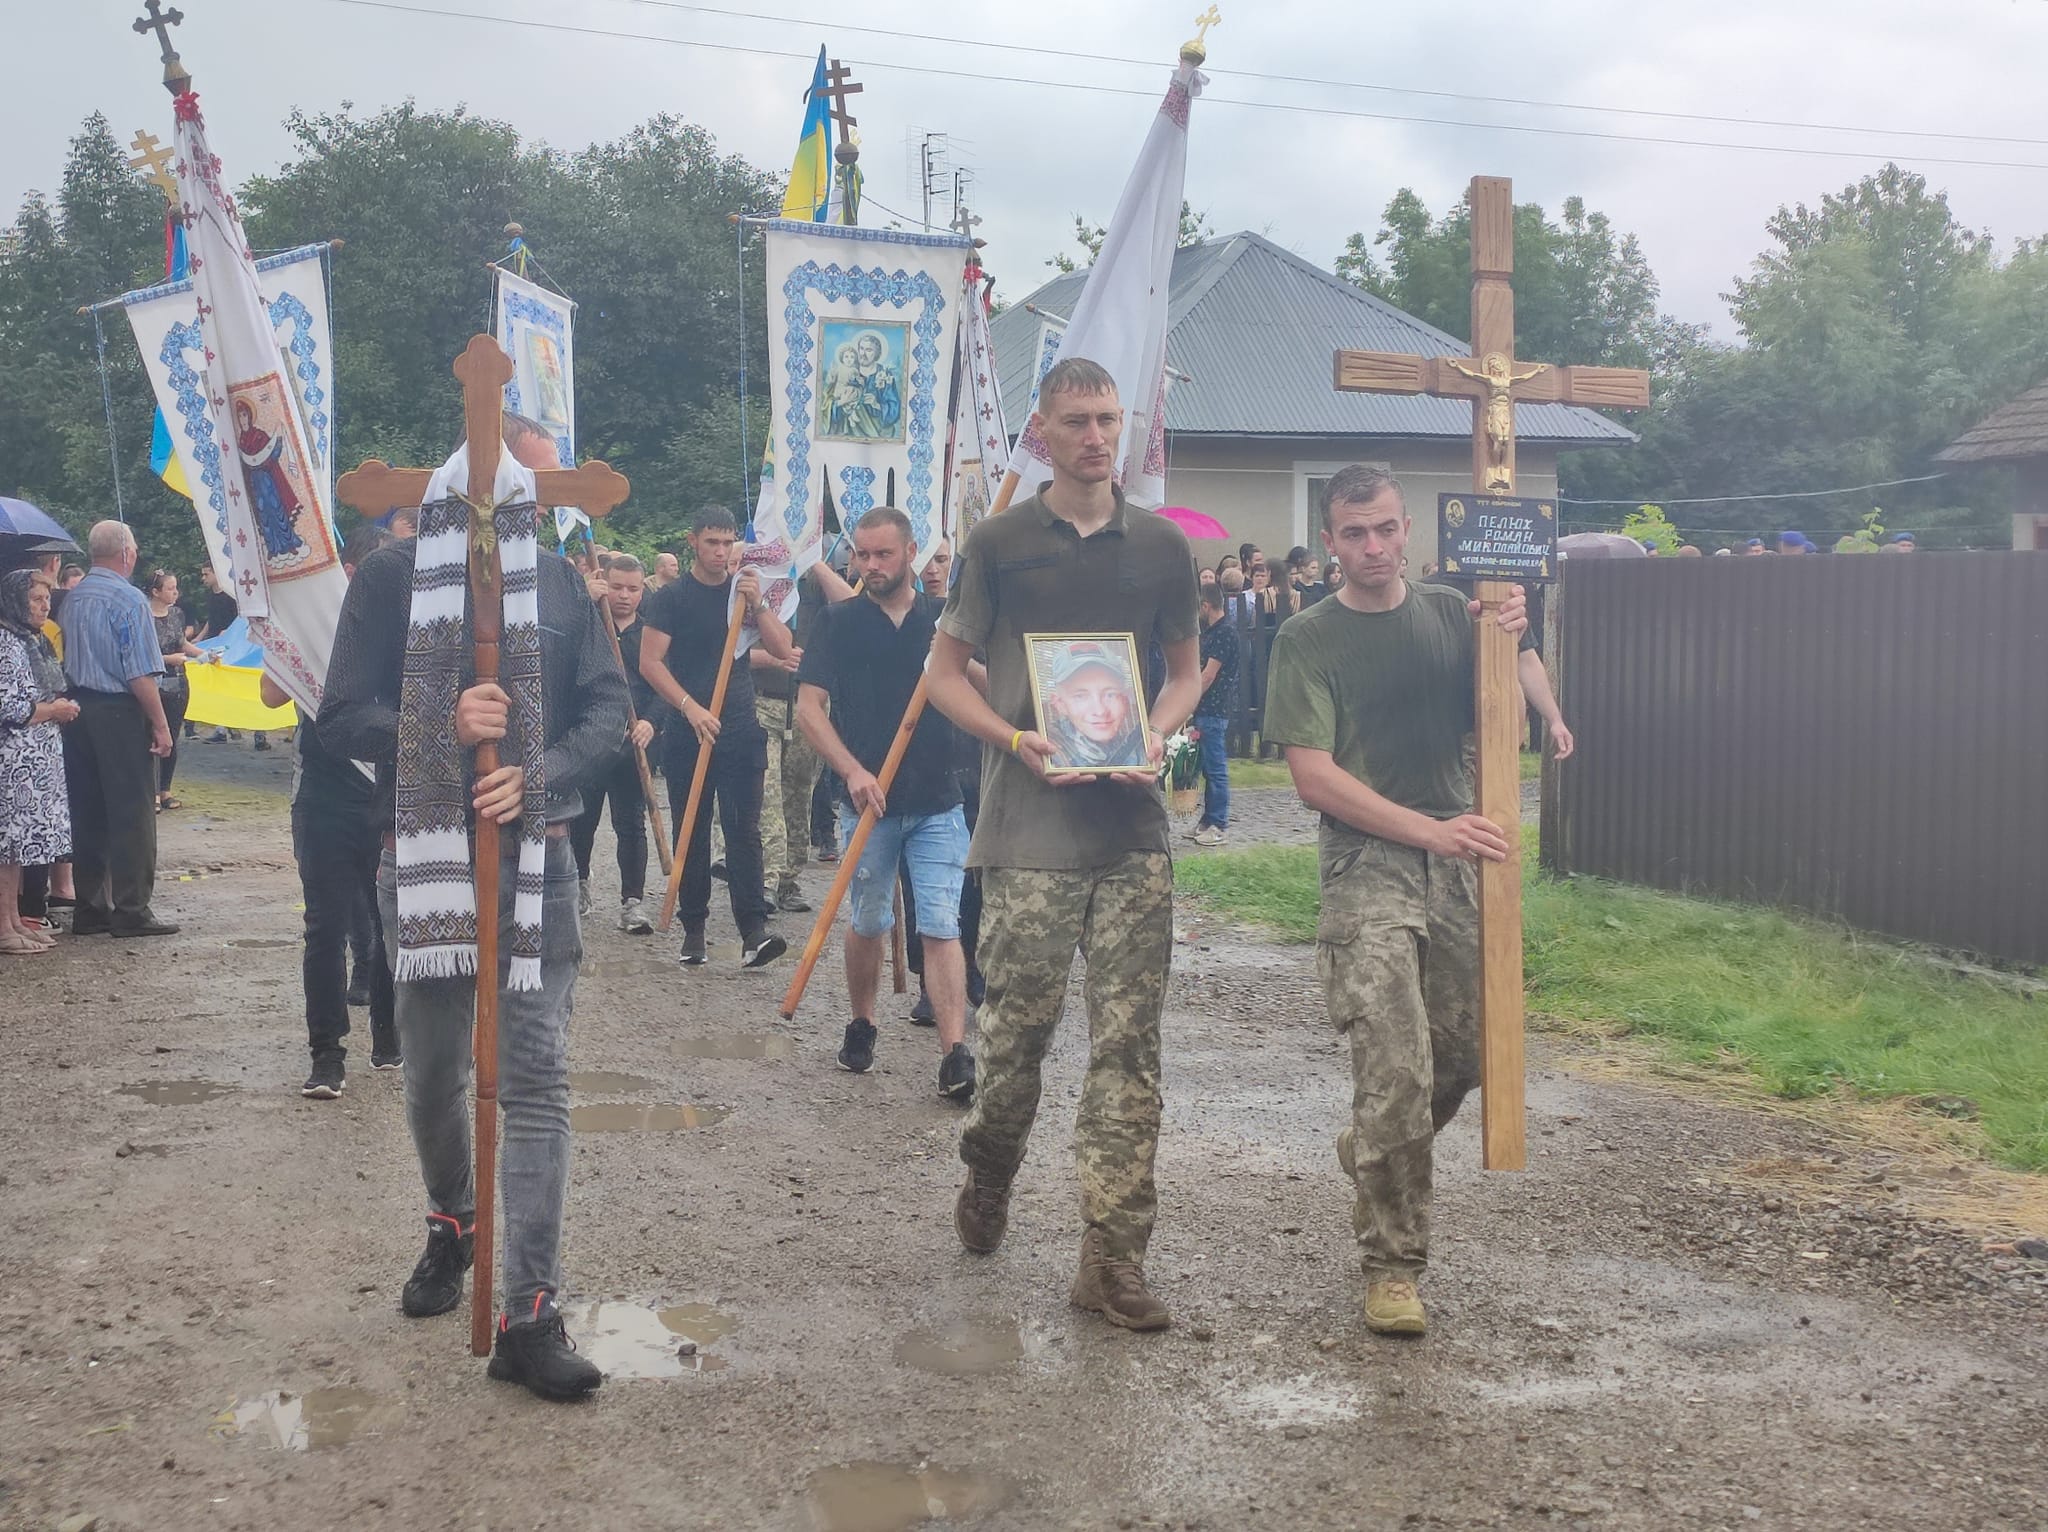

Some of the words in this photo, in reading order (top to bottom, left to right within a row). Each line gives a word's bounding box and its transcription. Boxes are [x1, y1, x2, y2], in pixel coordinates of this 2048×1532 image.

[1478, 515, 1533, 530] ПЕЛЮХ
[1484, 529, 1534, 543] РОМАН
[1458, 540, 1551, 556] МИКОЛАЙОВИЧ
